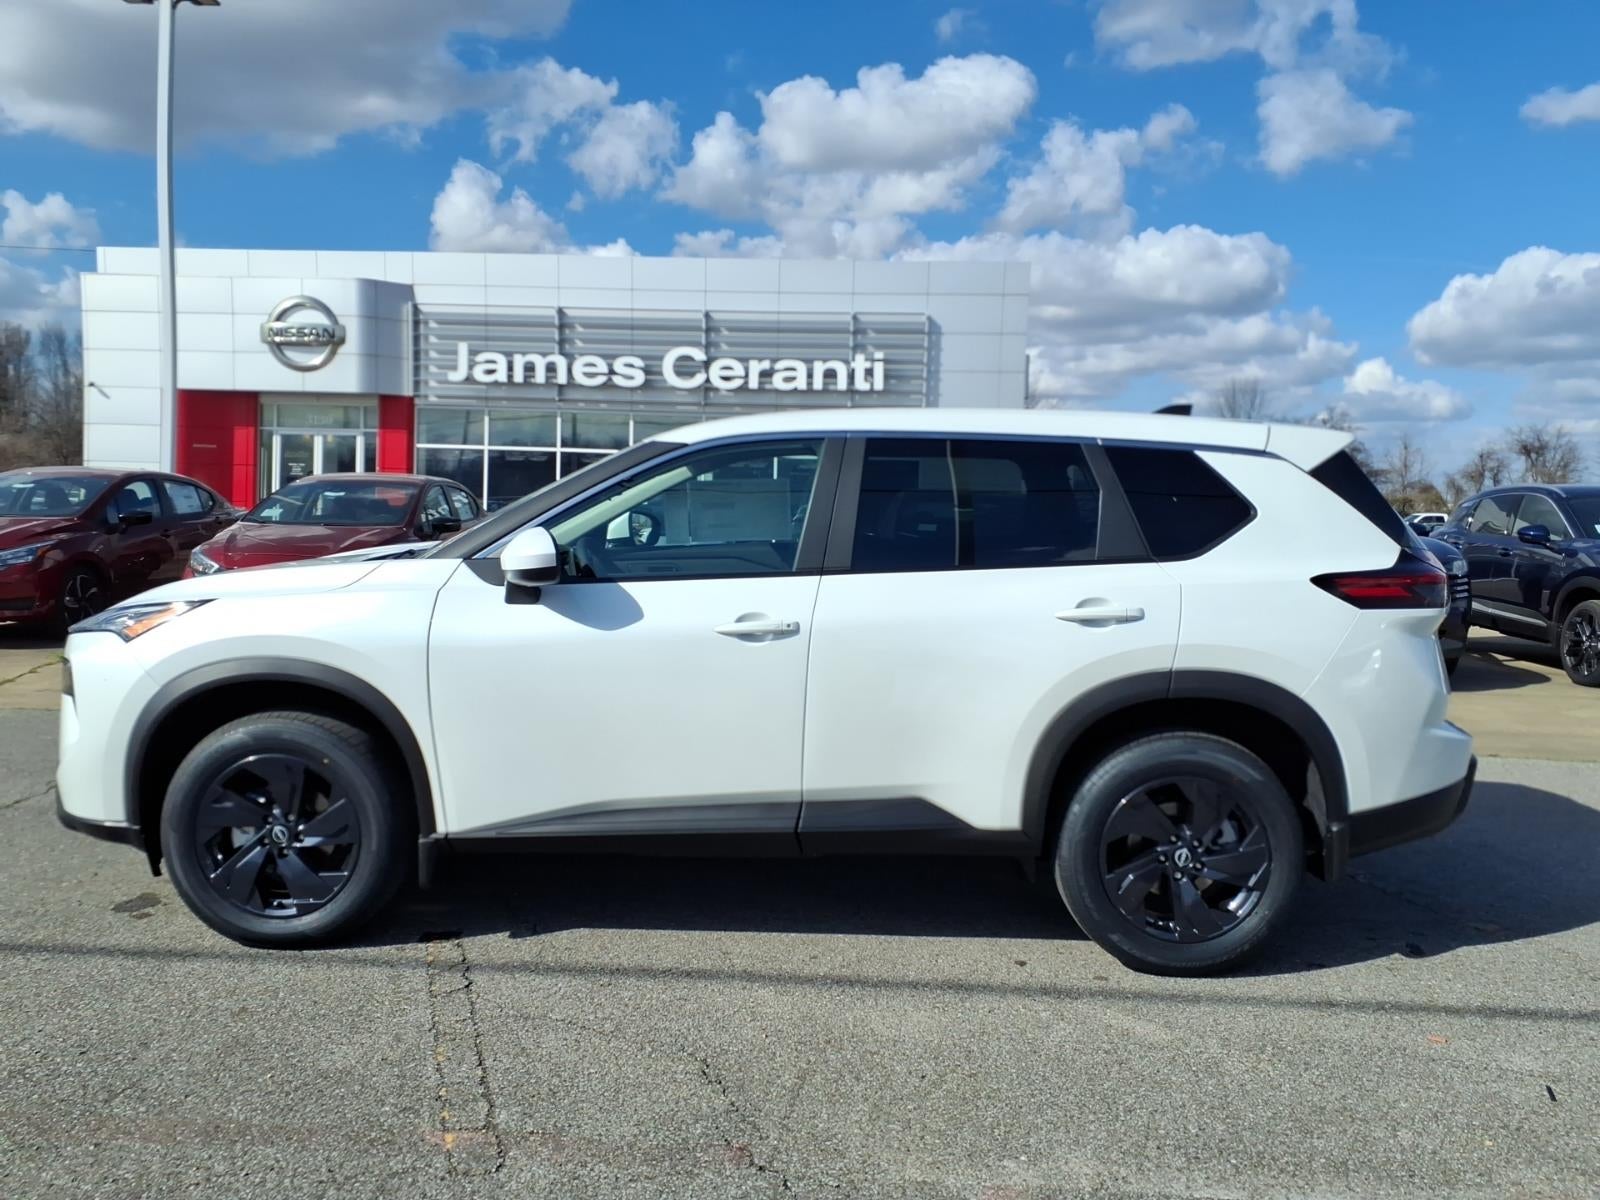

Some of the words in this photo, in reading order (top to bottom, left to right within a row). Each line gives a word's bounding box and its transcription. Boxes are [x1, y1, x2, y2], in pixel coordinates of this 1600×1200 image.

[267, 326, 335, 339] NISSAN
[447, 341, 646, 389] James
[661, 345, 885, 392] Ceranti
